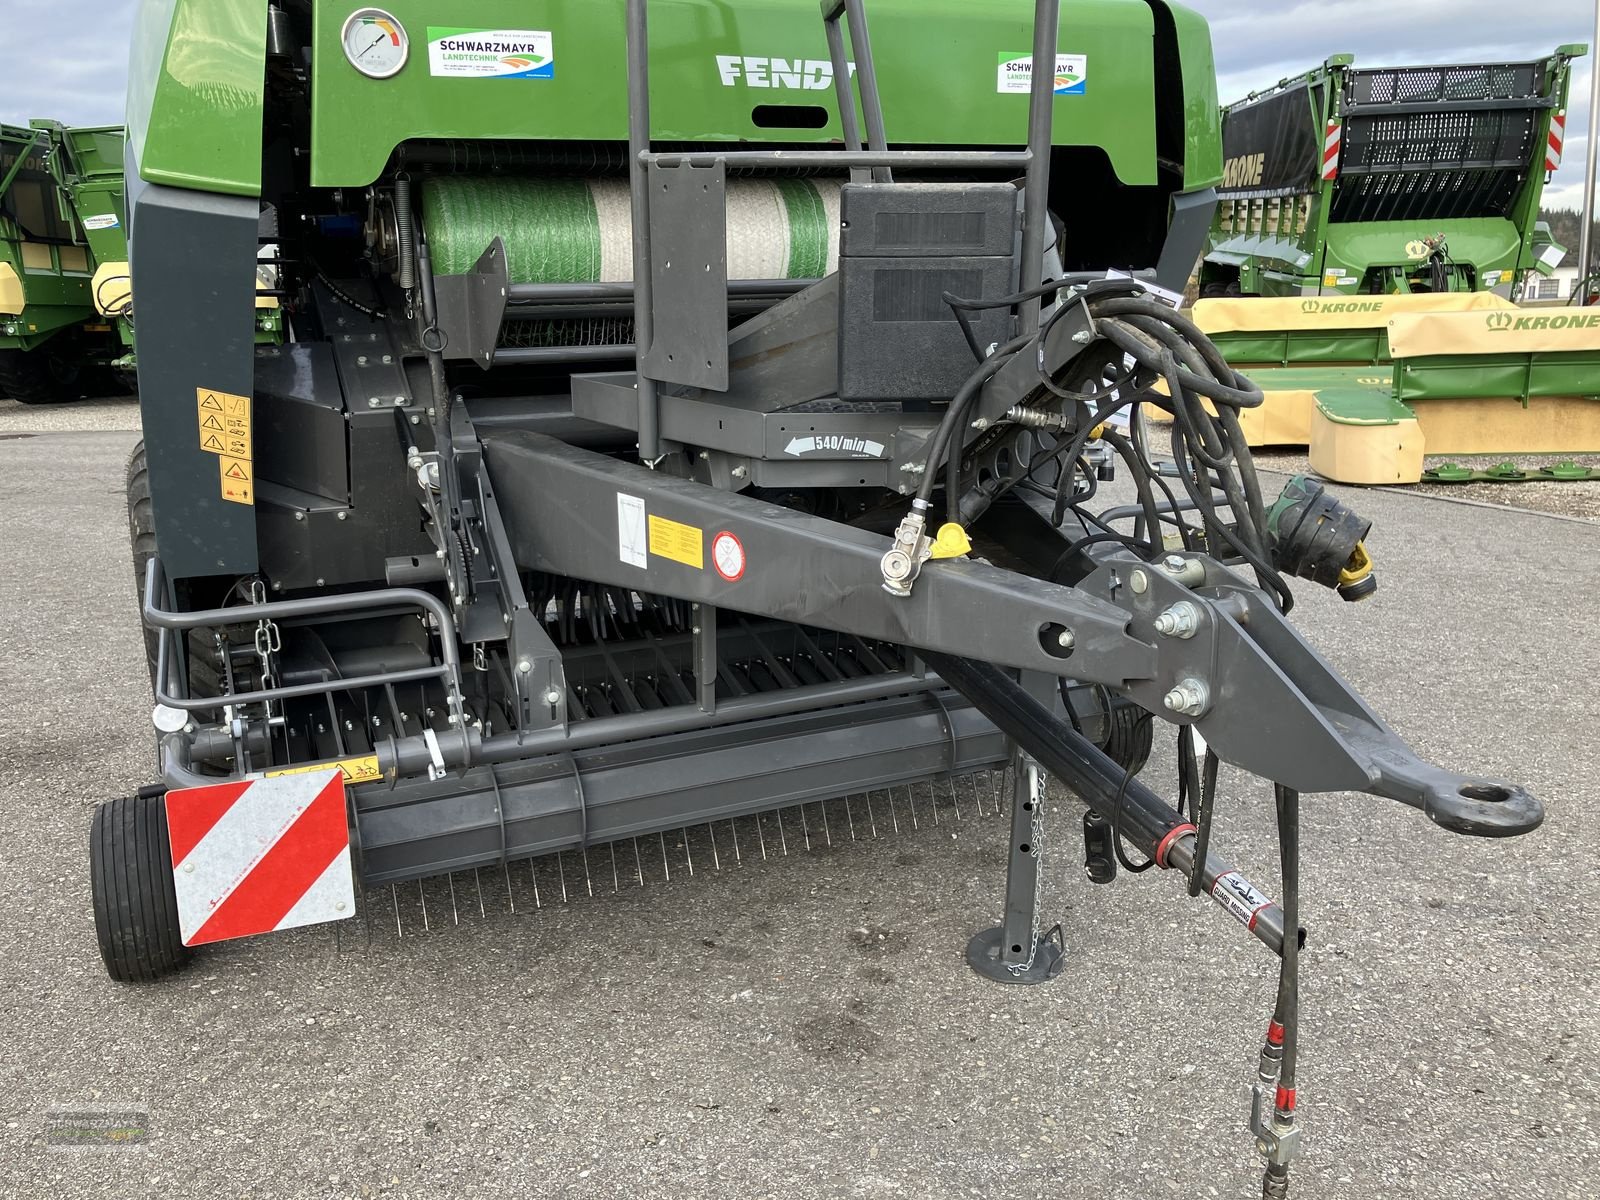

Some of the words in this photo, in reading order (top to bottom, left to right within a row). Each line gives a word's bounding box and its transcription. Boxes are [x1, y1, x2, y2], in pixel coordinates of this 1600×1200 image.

[440, 40, 535, 53] SCHWARZMAYR
[442, 53, 499, 62] LANDTECHNIK
[1220, 153, 1265, 188] KRONE
[1320, 302, 1383, 313] KRONE
[1513, 314, 1600, 331] KRONE
[815, 435, 865, 452] 540/min
[1213, 886, 1231, 905] GUARD
[1230, 901, 1251, 922] MISSING
